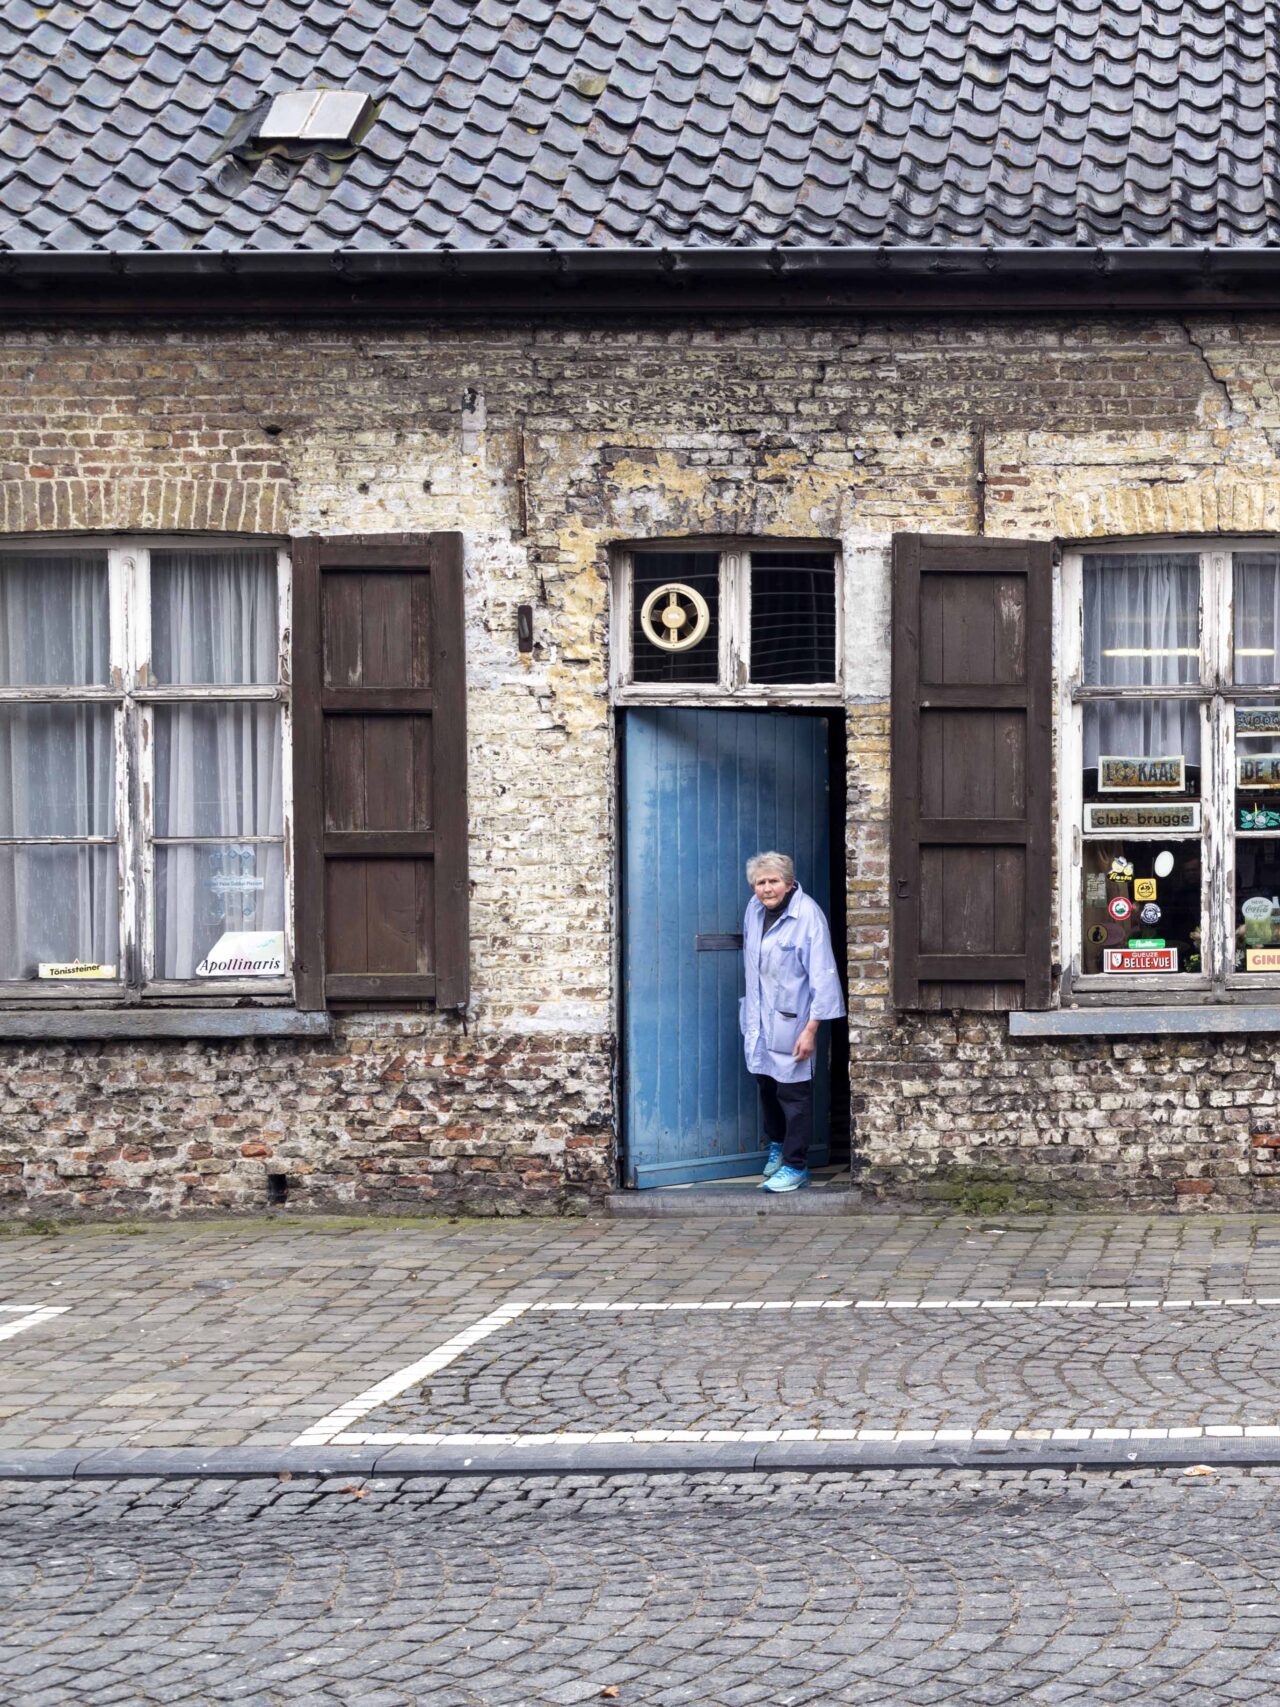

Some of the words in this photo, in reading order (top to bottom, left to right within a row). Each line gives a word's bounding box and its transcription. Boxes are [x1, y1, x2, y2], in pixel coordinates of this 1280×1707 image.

[1244, 761, 1264, 780] DE
[1096, 813, 1129, 826] club
[1137, 813, 1190, 827] brugge
[49, 964, 100, 976] Tönissteiner
[200, 957, 281, 974] Apollinaris
